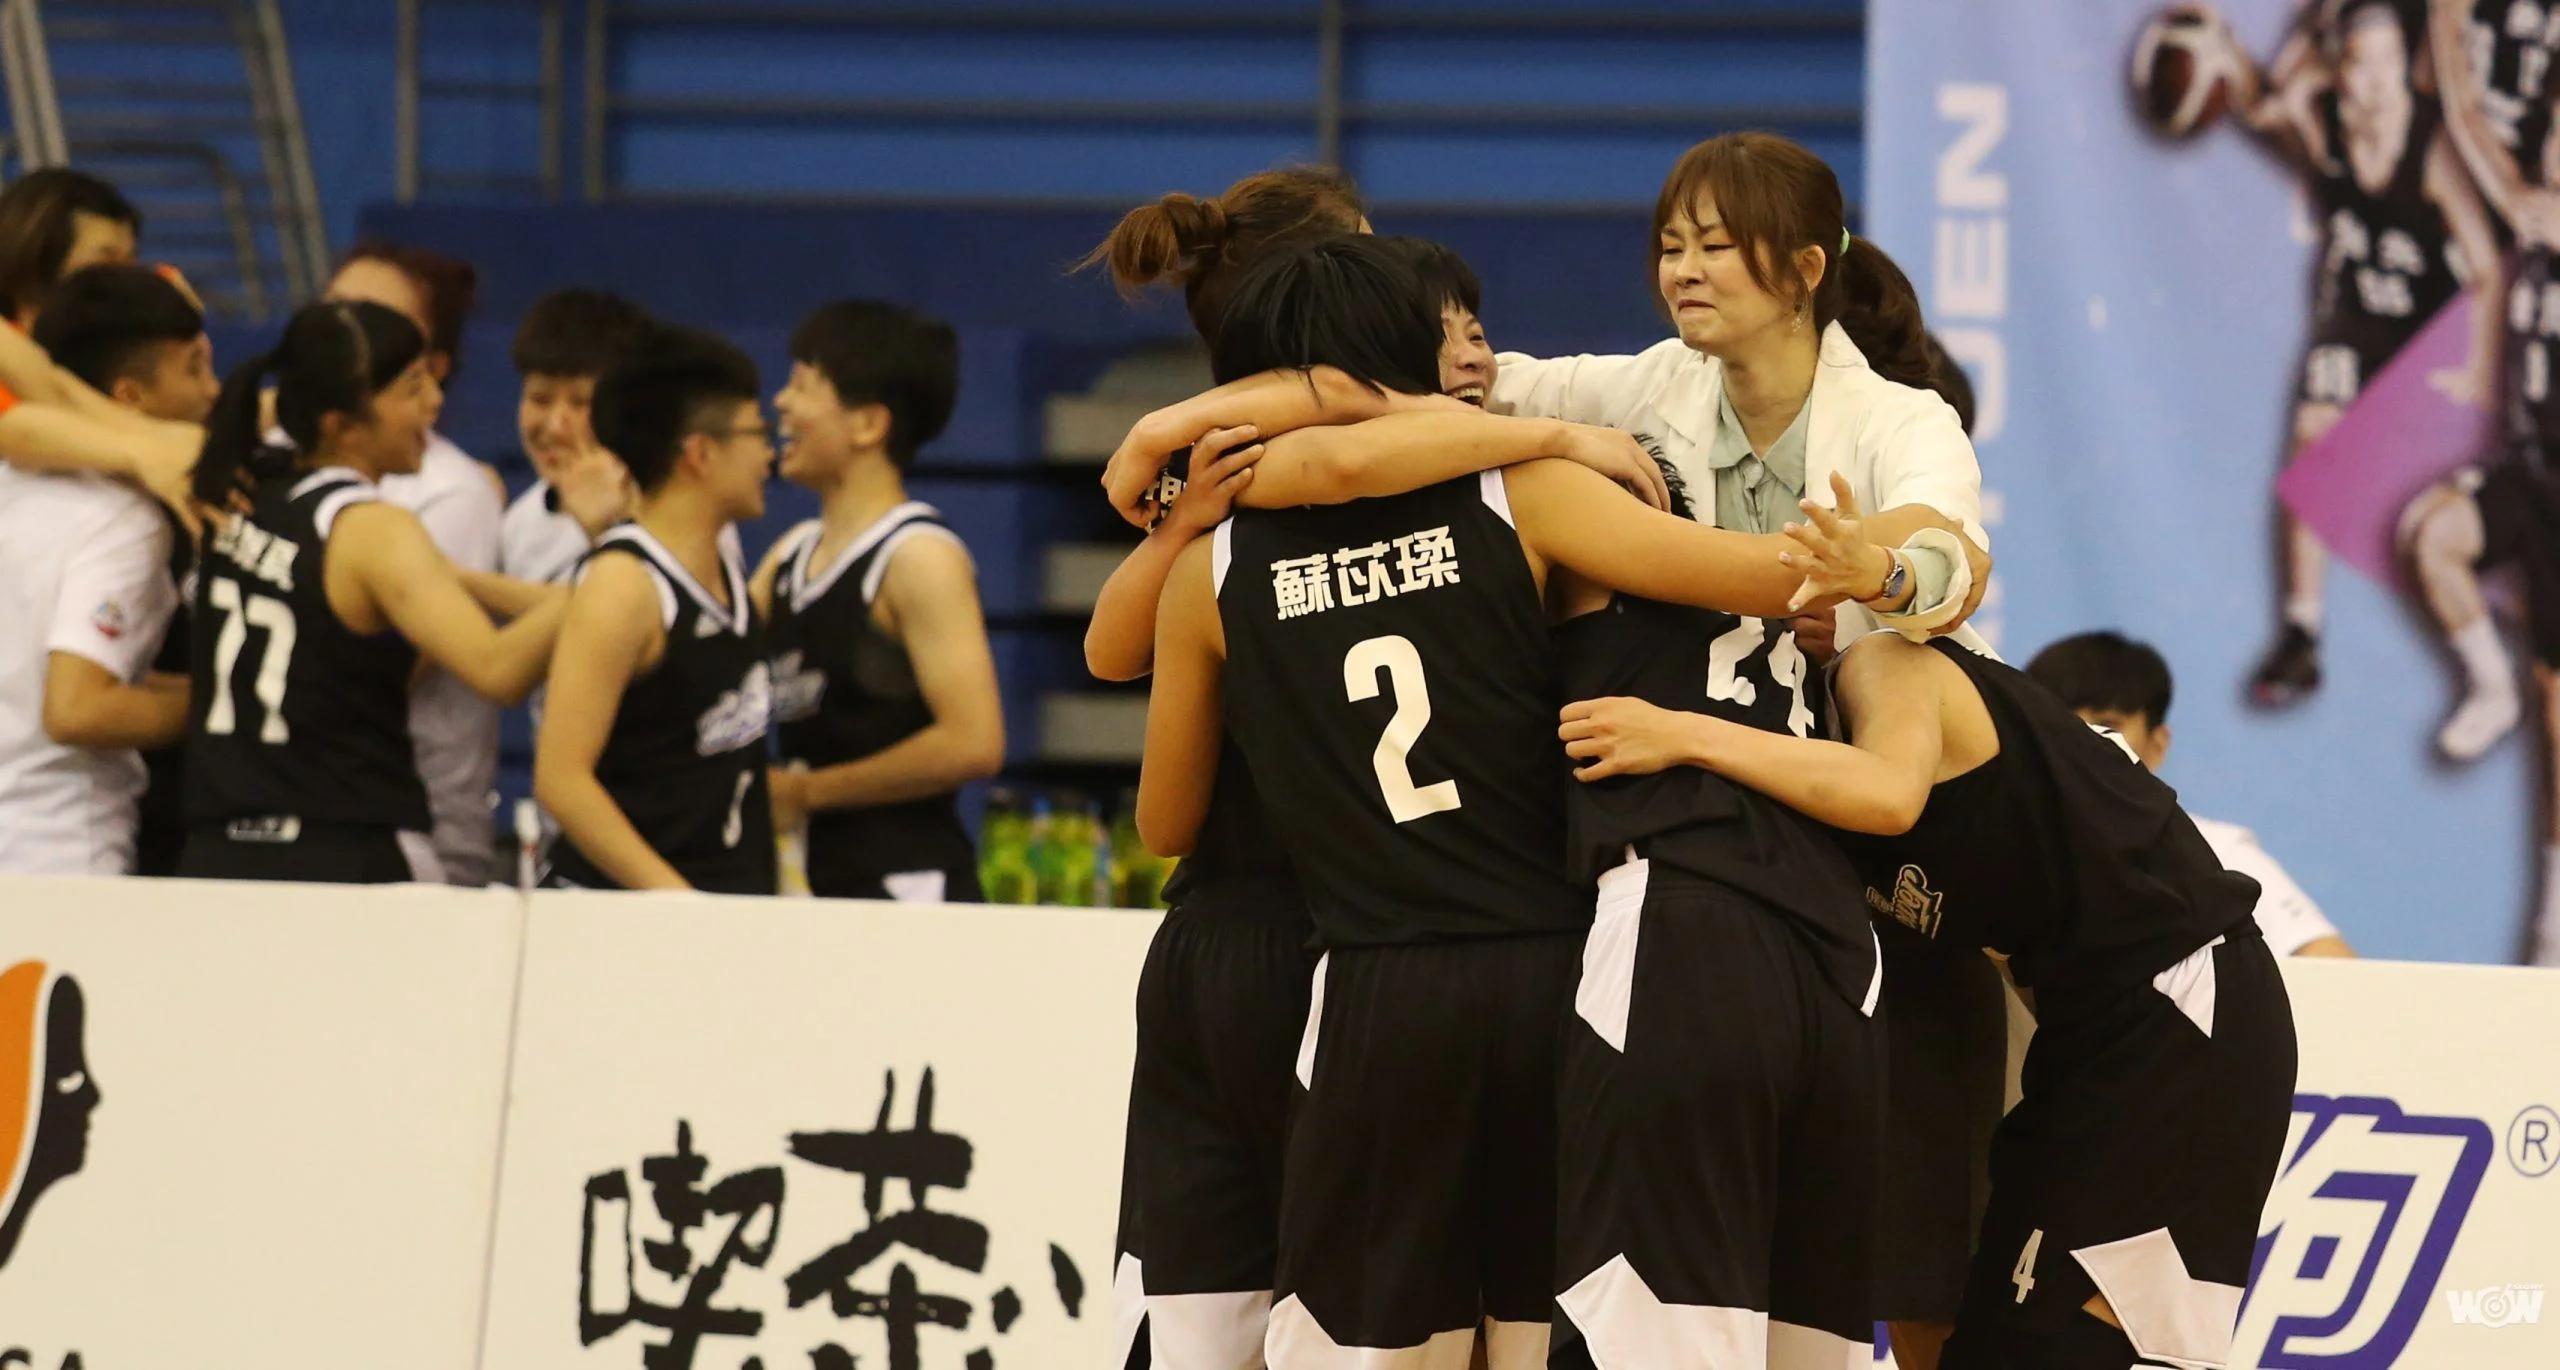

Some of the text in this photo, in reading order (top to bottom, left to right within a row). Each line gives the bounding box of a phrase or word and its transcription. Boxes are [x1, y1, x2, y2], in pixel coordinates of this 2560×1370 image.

[206, 576, 297, 744] 77
[1343, 634, 1462, 824] 2
[2012, 1228, 2044, 1304] 4
